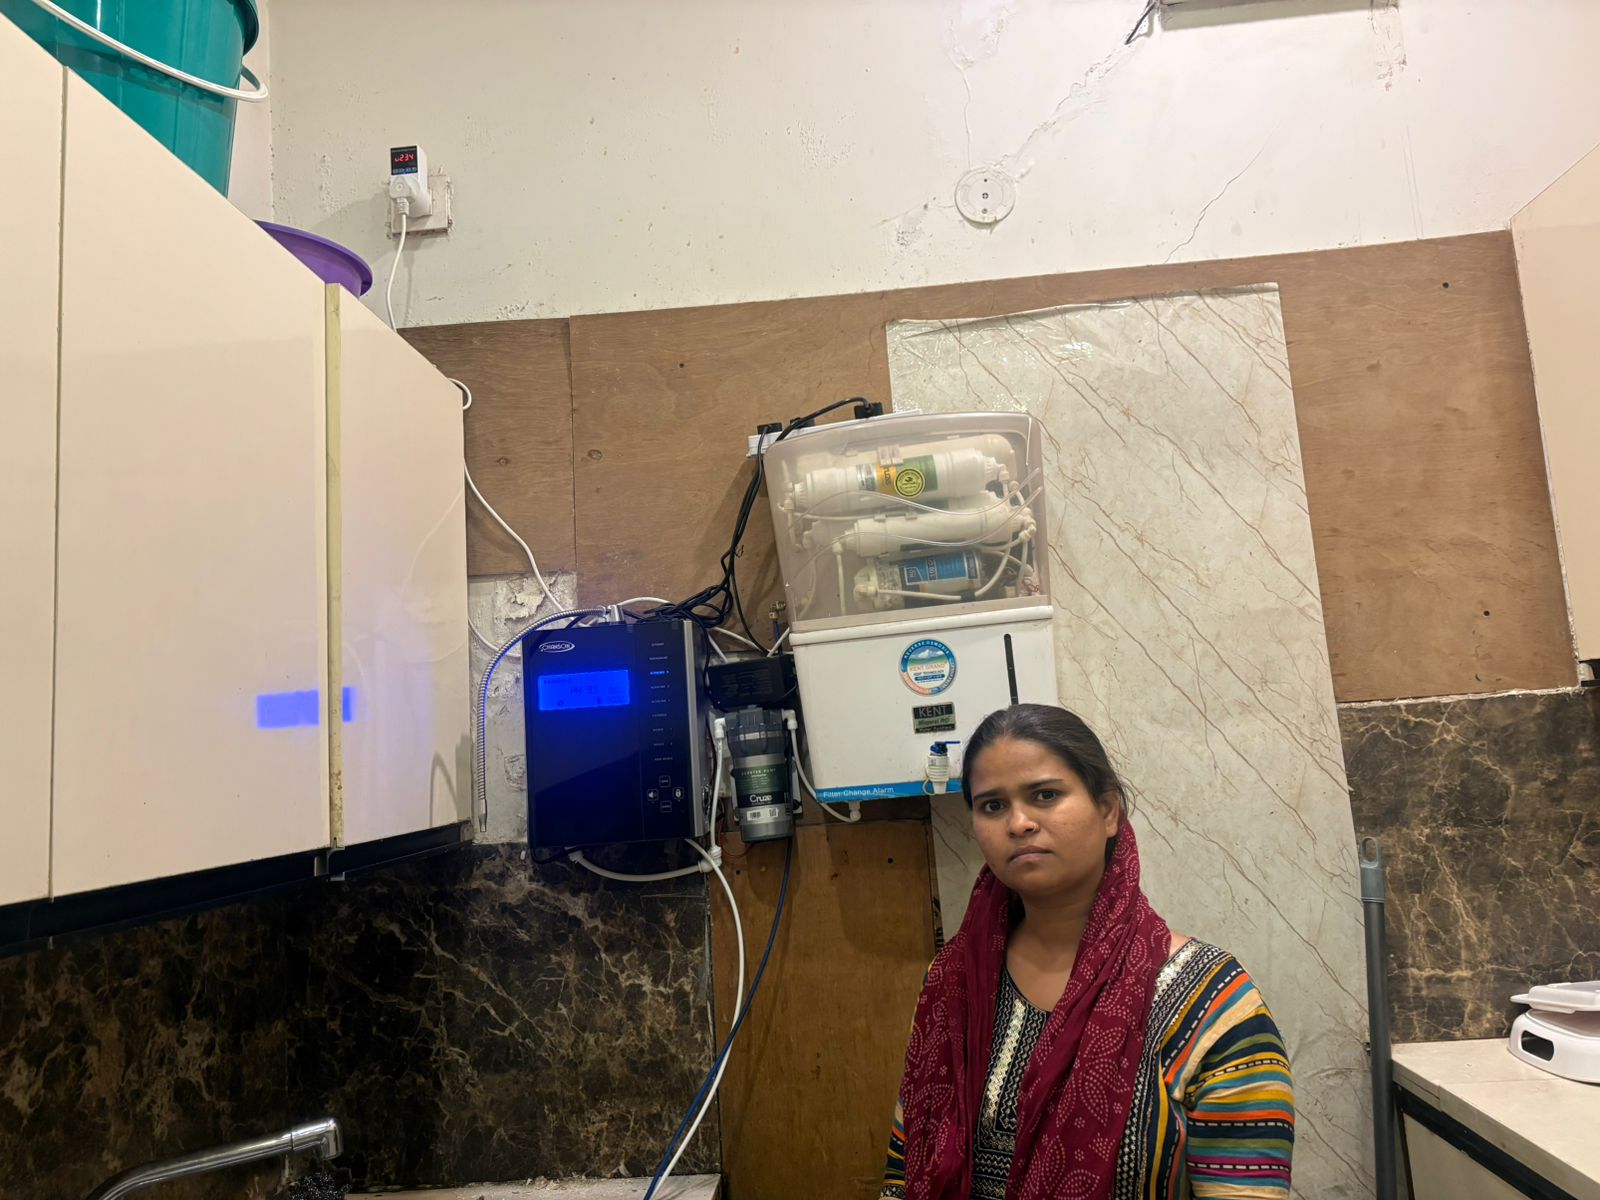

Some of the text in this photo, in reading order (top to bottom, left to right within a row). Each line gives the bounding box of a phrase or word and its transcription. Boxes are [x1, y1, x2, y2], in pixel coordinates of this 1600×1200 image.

[919, 705, 947, 717] KENT
[843, 788, 871, 797] Change
[872, 786, 895, 794] Alarm
